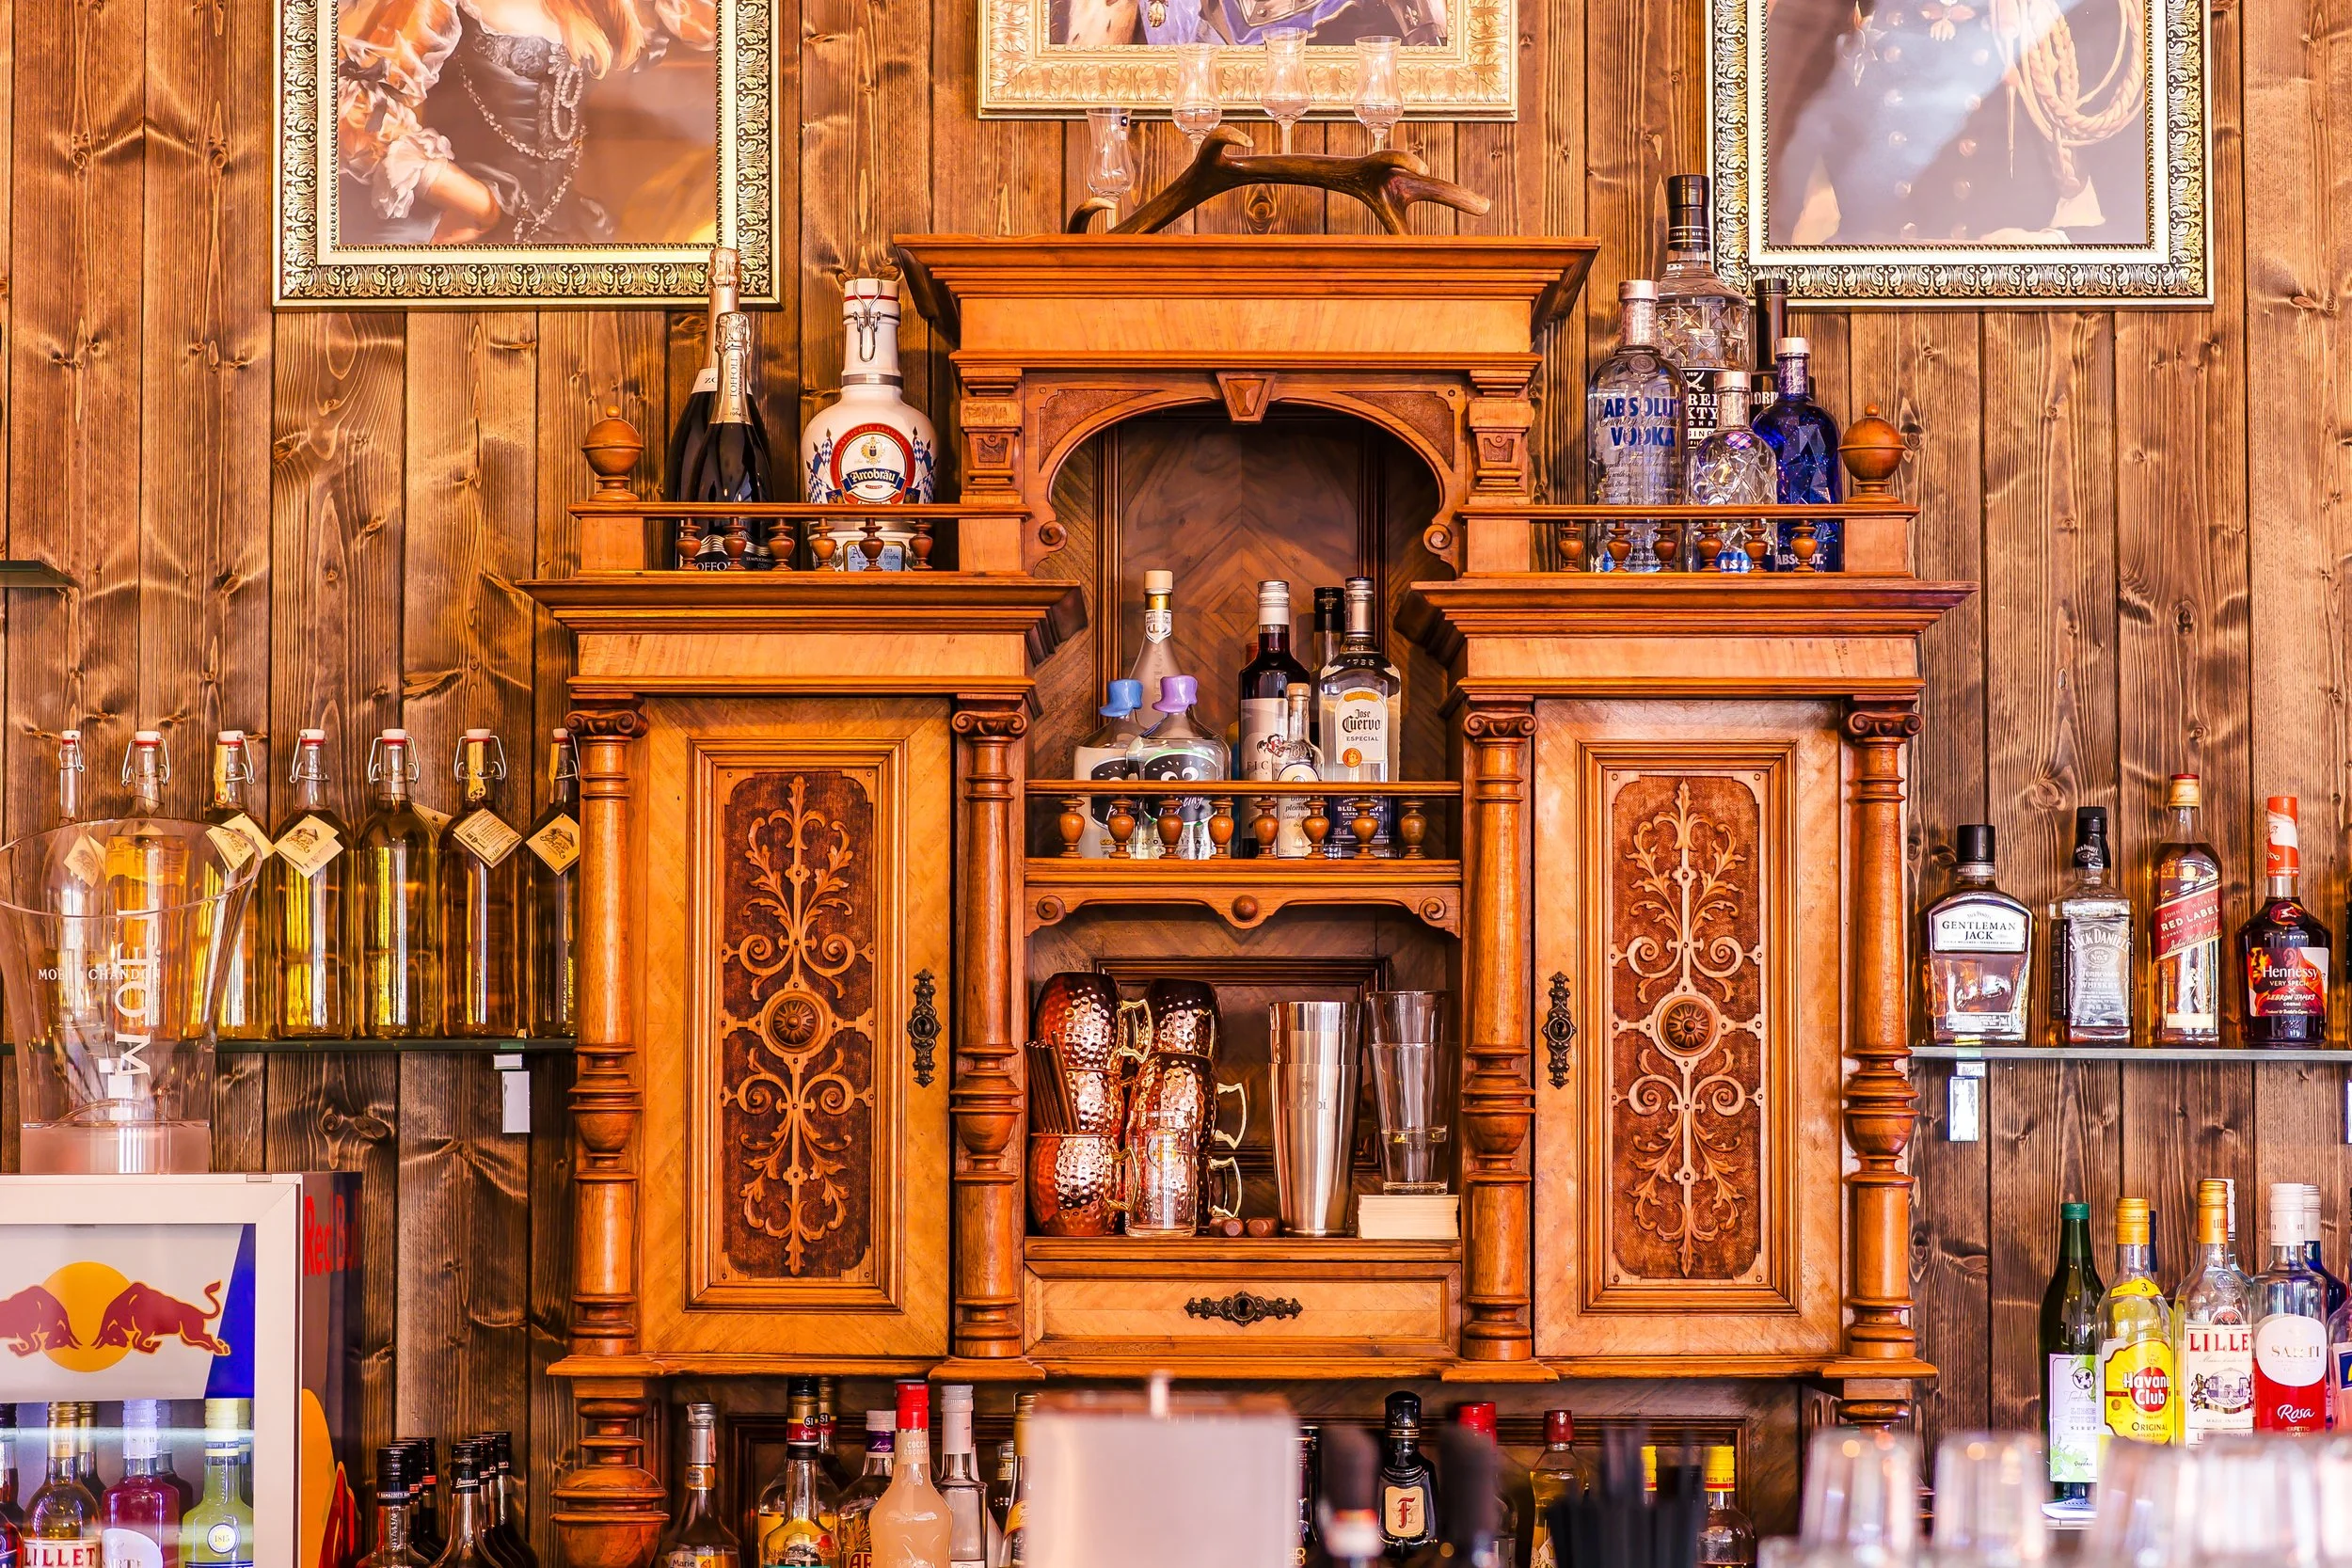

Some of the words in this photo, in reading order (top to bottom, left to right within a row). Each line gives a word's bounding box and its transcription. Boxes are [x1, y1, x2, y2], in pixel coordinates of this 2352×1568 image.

[1611, 426, 1677, 448] VODKA
[1355, 708, 1371, 719] Jose
[1342, 715, 1381, 733] Cuervo
[2160, 917, 2184, 931] RED
[2185, 904, 2220, 923] LABEL
[1942, 921, 2016, 930] GENTLEMAN
[1964, 931, 1994, 941] JACK
[2069, 932, 2092, 952] JACK
[2263, 965, 2318, 980] Hennessy
[304, 1190, 333, 1276] Red
[2141, 1282, 2148, 1292] 3
[2271, 1345, 2320, 1357] SARTI
[2135, 1389, 2166, 1405] Club
[820, 1415, 829, 1423] 51
[2277, 1404, 2315, 1422] Rosa
[805, 1418, 814, 1426] 51
[1397, 1497, 1416, 1528] F
[215, 1534, 230, 1543] 1815
[24, 1547, 95, 1567] LILLET
